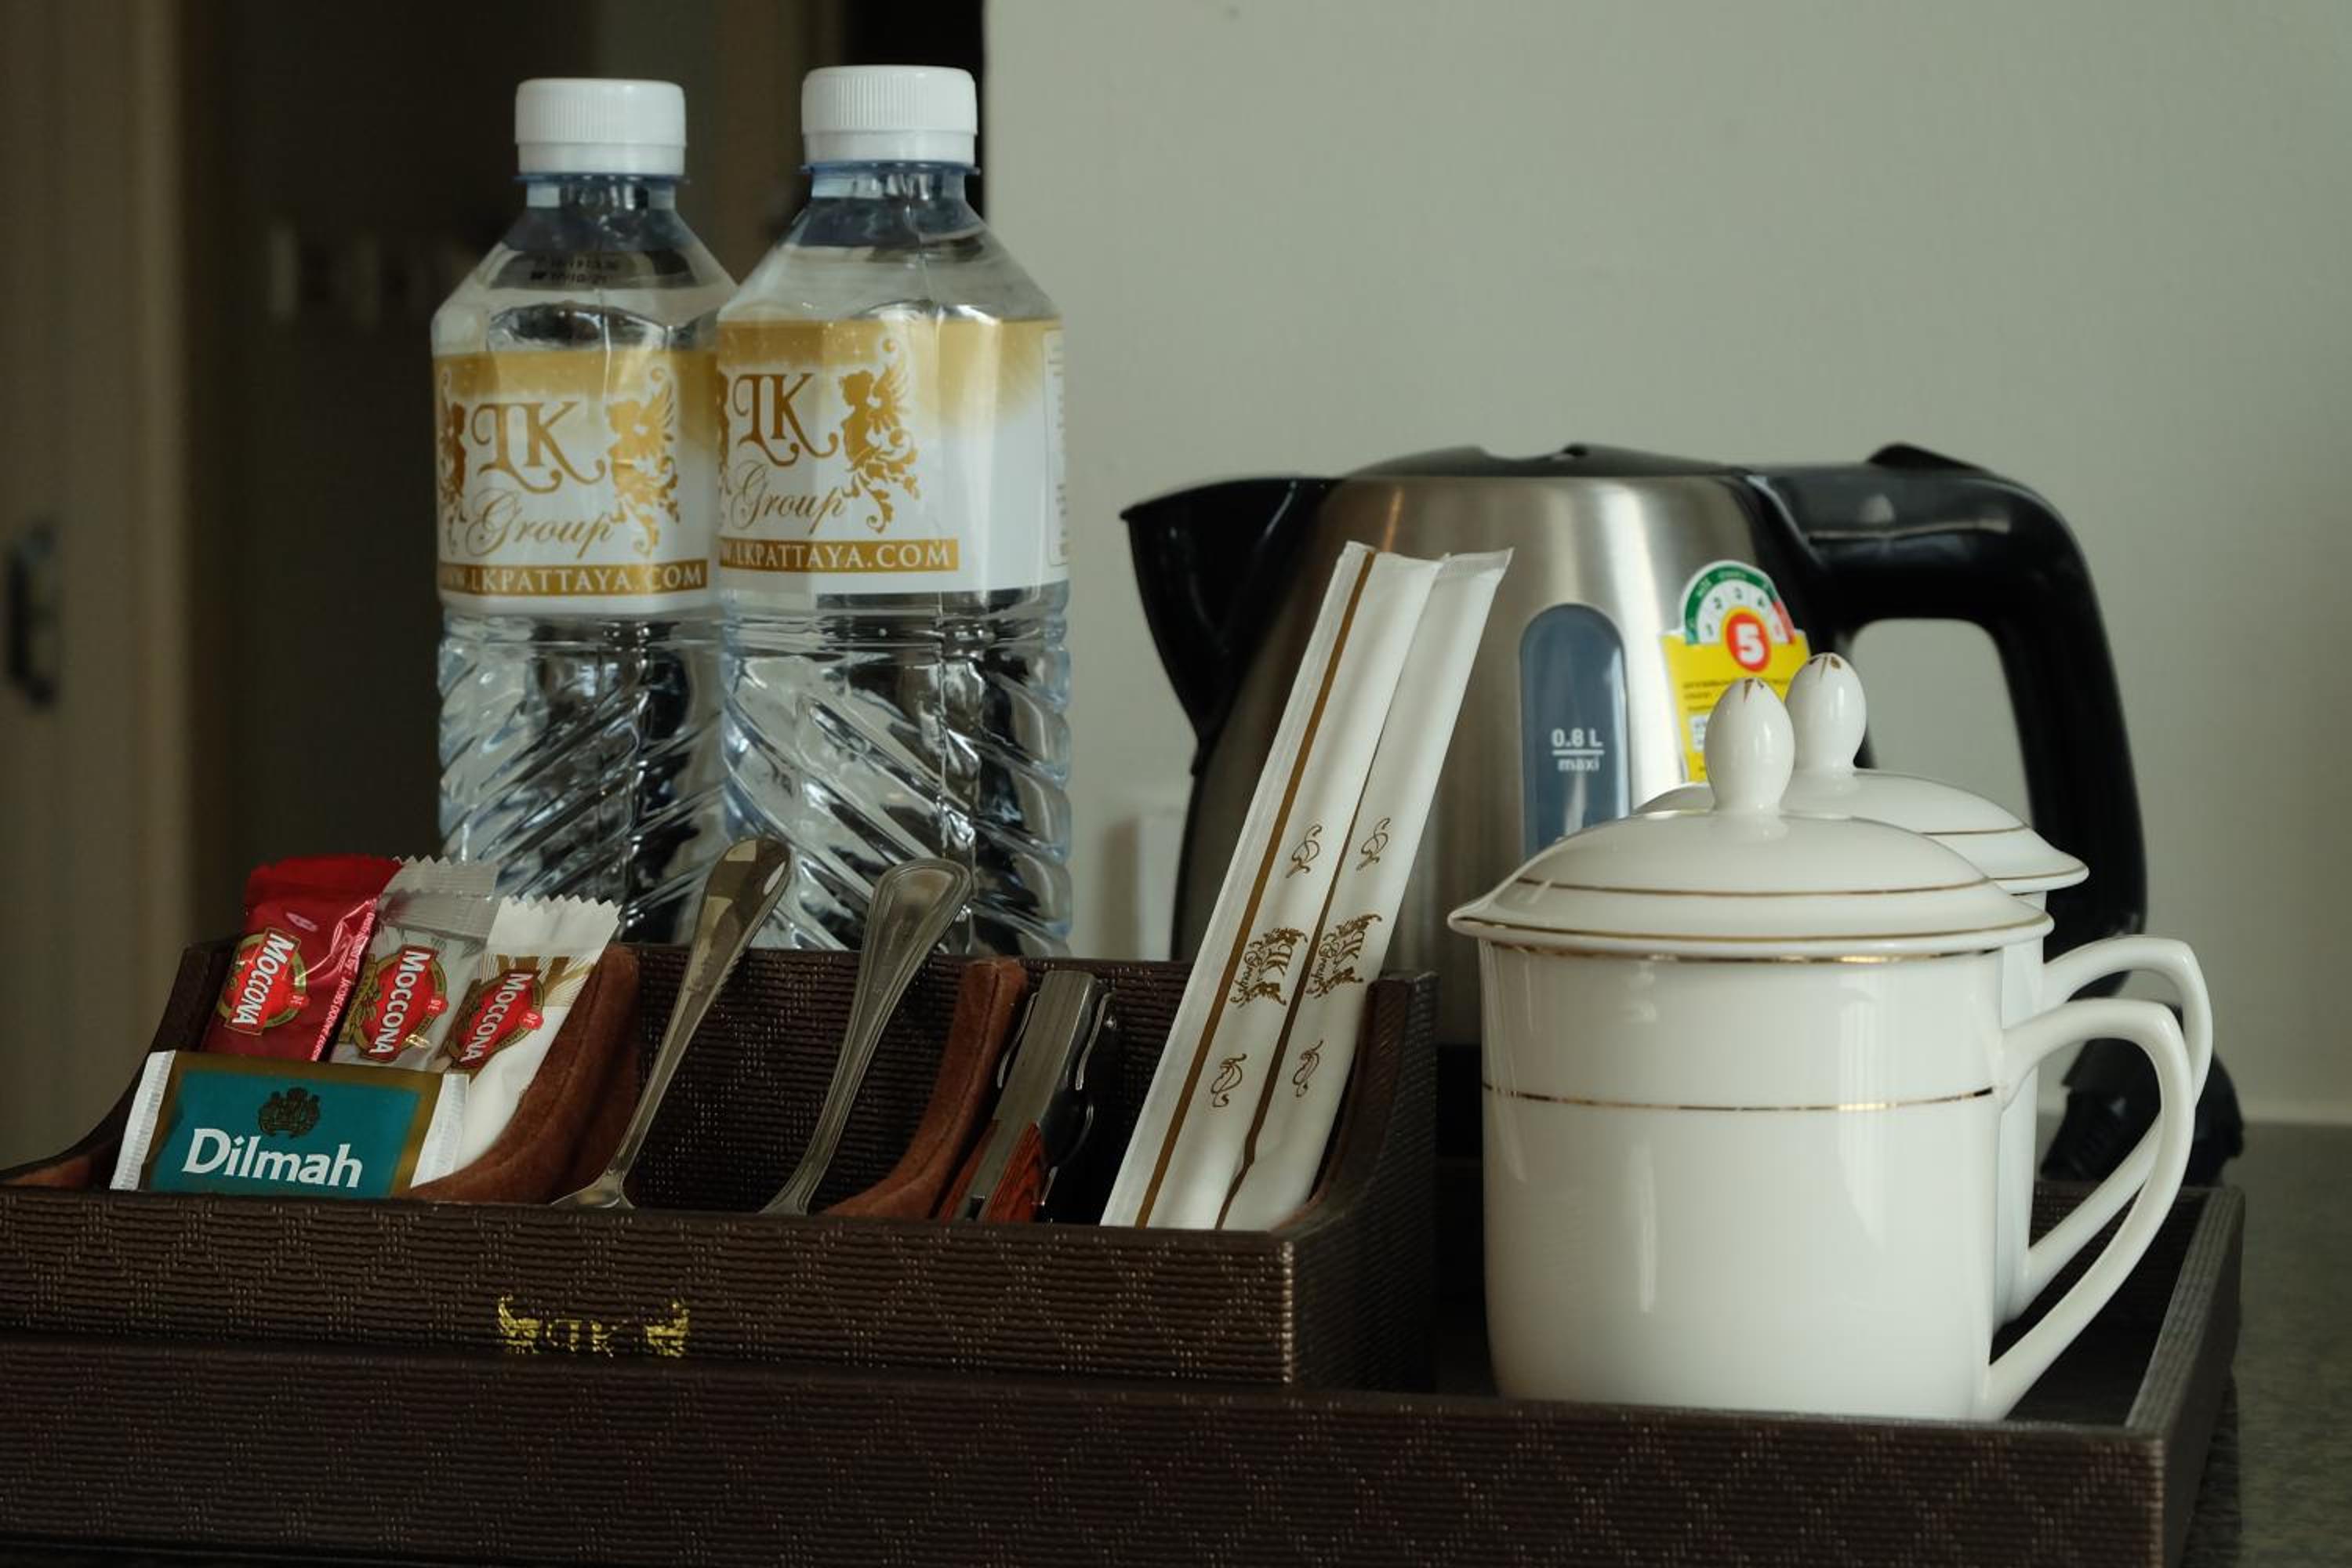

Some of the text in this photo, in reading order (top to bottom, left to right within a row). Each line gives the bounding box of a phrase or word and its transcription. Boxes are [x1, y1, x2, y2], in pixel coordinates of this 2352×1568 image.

[466, 488, 615, 560] Group
[731, 459, 847, 535] Group
[1735, 623, 1766, 664] 5
[1551, 728, 1604, 748] 0.8 L
[1557, 755, 1600, 772] maxi
[232, 933, 295, 1025] MOCCONA
[368, 950, 431, 1054] MOCCONA
[459, 972, 534, 1062] MOCCONA
[181, 1127, 364, 1189] Dilmah
